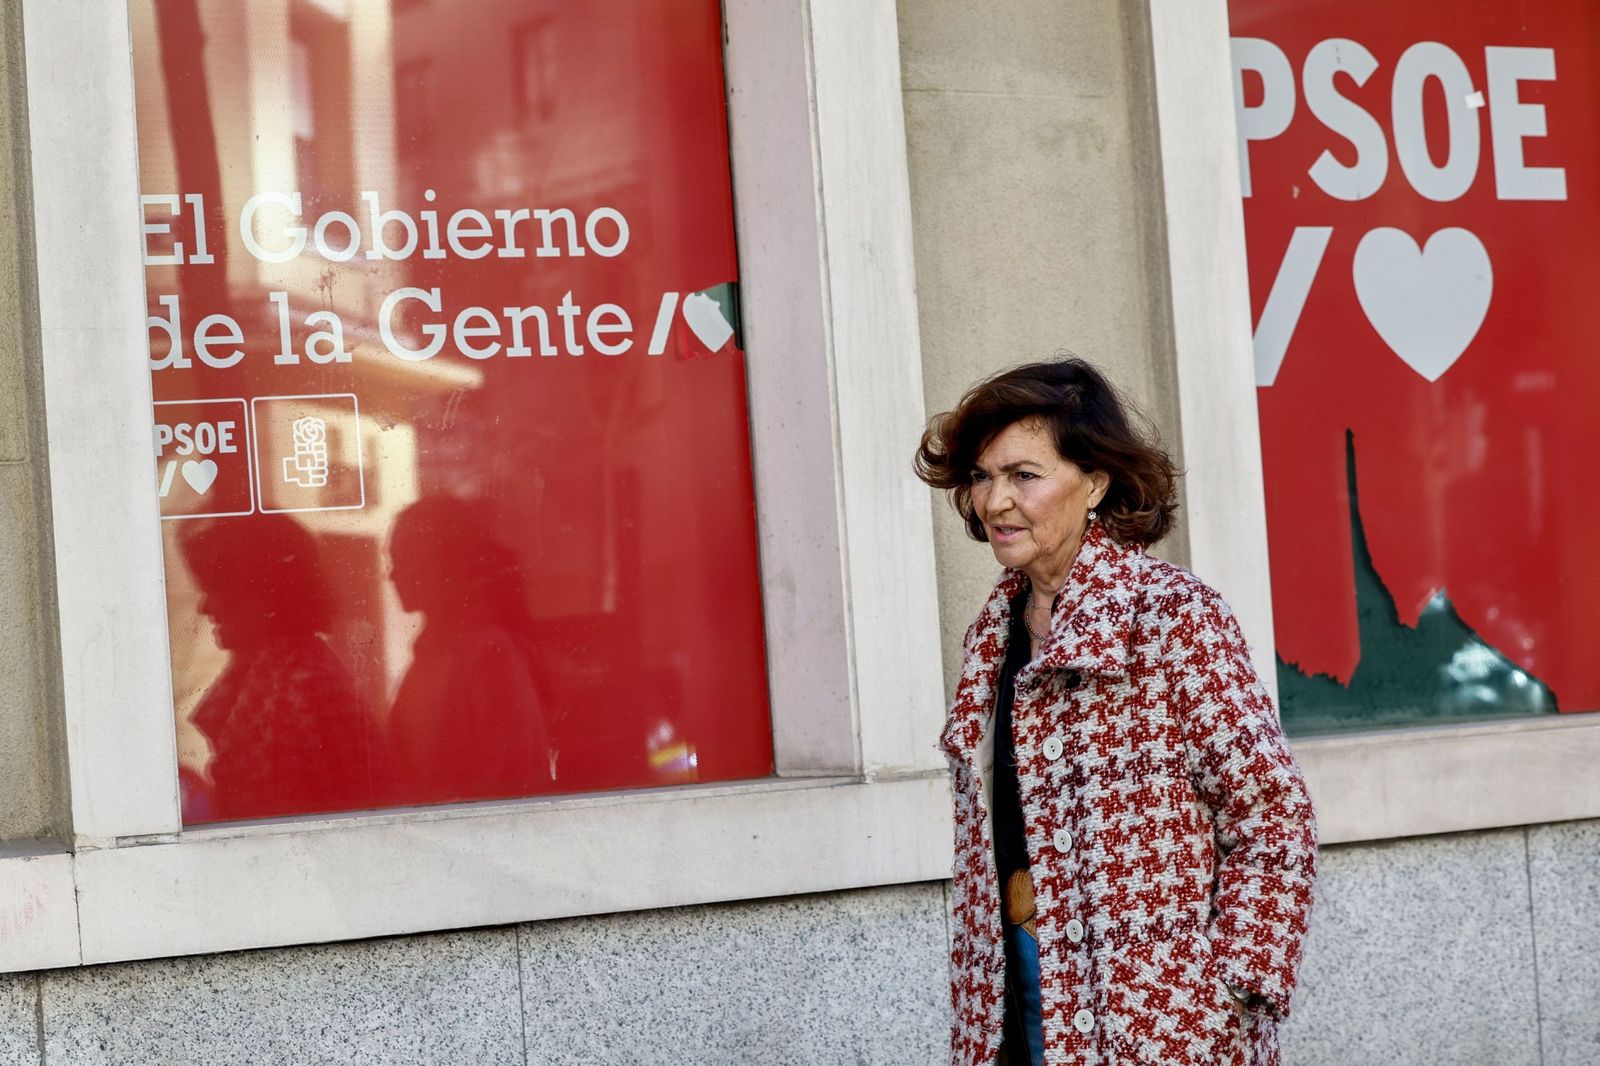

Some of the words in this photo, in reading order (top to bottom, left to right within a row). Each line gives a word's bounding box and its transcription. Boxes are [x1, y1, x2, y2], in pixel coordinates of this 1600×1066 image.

[1229, 37, 1567, 201] PSOE
[140, 194, 215, 266] El
[239, 189, 630, 263] Gobierno
[147, 294, 246, 371] de
[269, 291, 353, 366] la
[378, 287, 634, 362] Gente
[153, 421, 238, 457] PSOE
